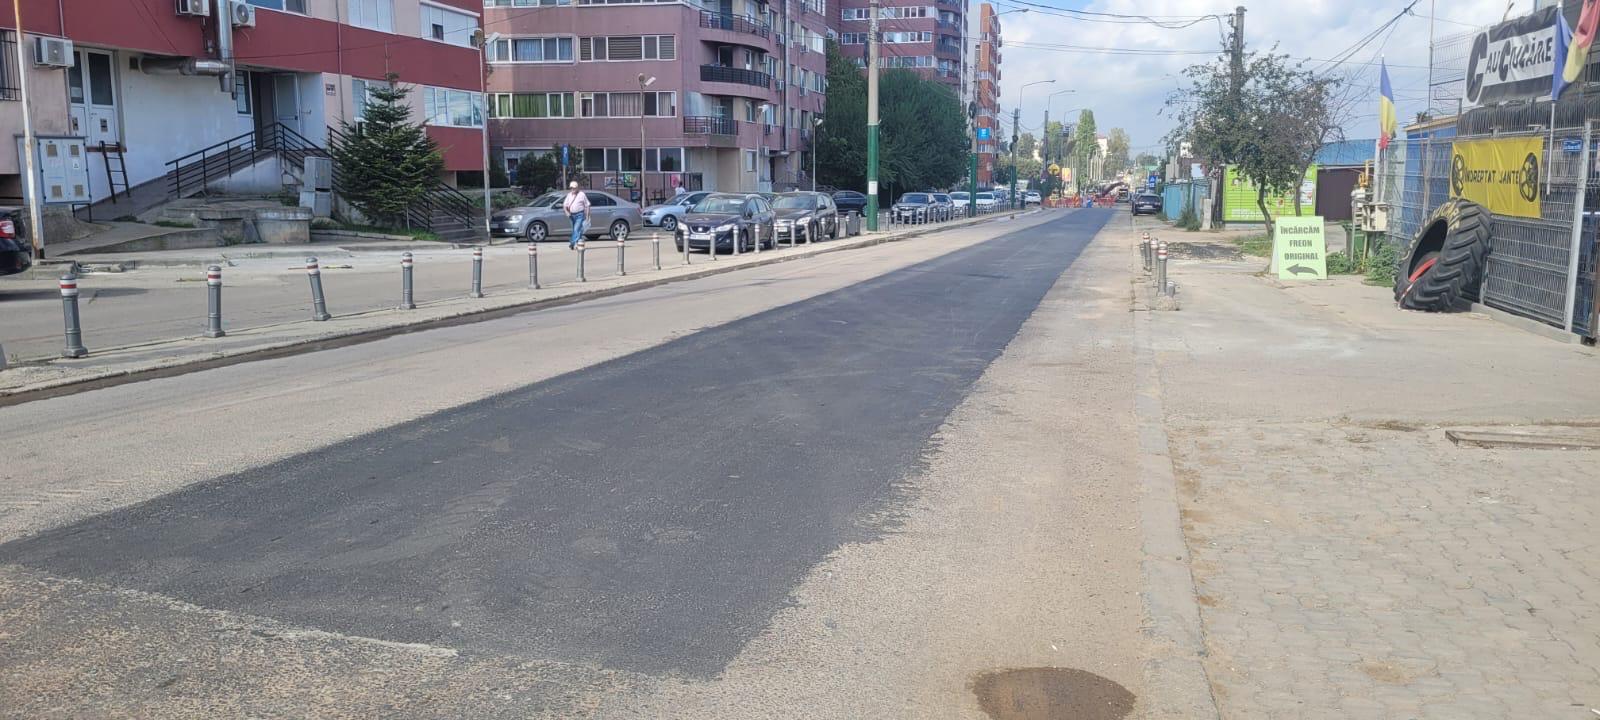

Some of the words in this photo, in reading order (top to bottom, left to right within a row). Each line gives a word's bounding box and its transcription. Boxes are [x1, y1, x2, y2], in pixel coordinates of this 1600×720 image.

[1498, 170, 1519, 184] JANTE
[1289, 239, 1312, 247] FREON
[1284, 252, 1319, 260] ORIGINAL
